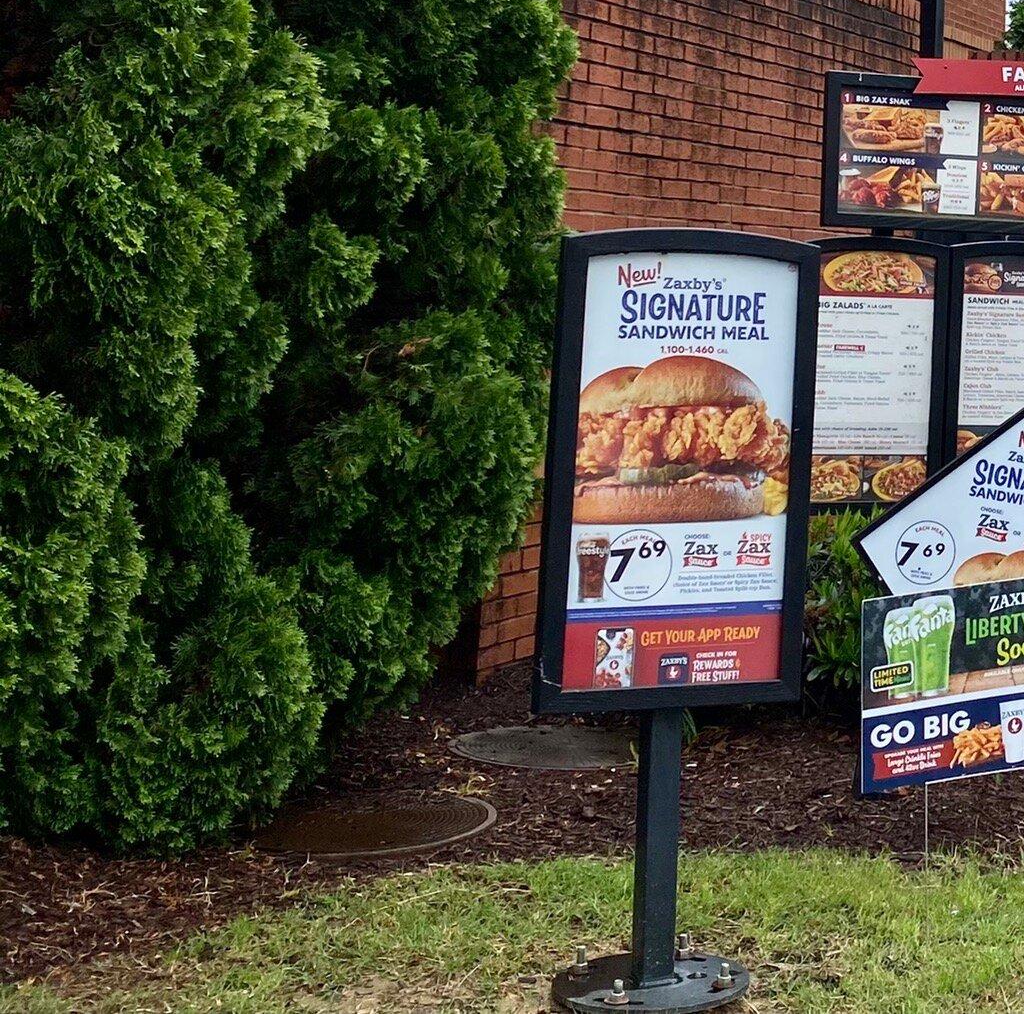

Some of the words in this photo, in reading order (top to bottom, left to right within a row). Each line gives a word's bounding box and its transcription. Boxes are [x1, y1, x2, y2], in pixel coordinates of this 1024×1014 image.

[844, 94, 850, 102] 1
[856, 95, 870, 103] BIG
[871, 96, 888, 104] ZAX
[889, 97, 911, 105] SNAK
[984, 104, 991, 112] 2
[840, 153, 847, 162] 4
[853, 154, 888, 164] BUFFALO
[889, 157, 916, 166] WINGS
[981, 162, 988, 170] 5
[617, 261, 662, 288] New!
[662, 277, 724, 293] Zaxby's
[620, 289, 767, 325] SIGNATURE
[833, 302, 864, 310] ZALADS
[967, 297, 1010, 305] SANDWICH
[618, 325, 716, 340] SANDWICH
[721, 326, 770, 341] MEAL
[978, 513, 1010, 531] Zax
[751, 533, 772, 542] SPICY
[915, 525, 930, 533] EACH
[930, 526, 945, 536] MEAL
[683, 541, 719, 556] Zax
[737, 540, 771, 555] Zax
[640, 630, 664, 646] GET
[665, 629, 695, 645] YOUR
[698, 627, 721, 643] APP
[723, 626, 761, 642] READY
[692, 659, 735, 672] REWARDS
[691, 672, 711, 684] FREE
[712, 670, 740, 683] STUFF!
[873, 666, 909, 680] LIMITED
[873, 676, 894, 687] TIME
[870, 720, 916, 748] GO
[923, 710, 970, 740] BIG
[891, 765, 905, 774] and
[919, 759, 937, 770] Drink
